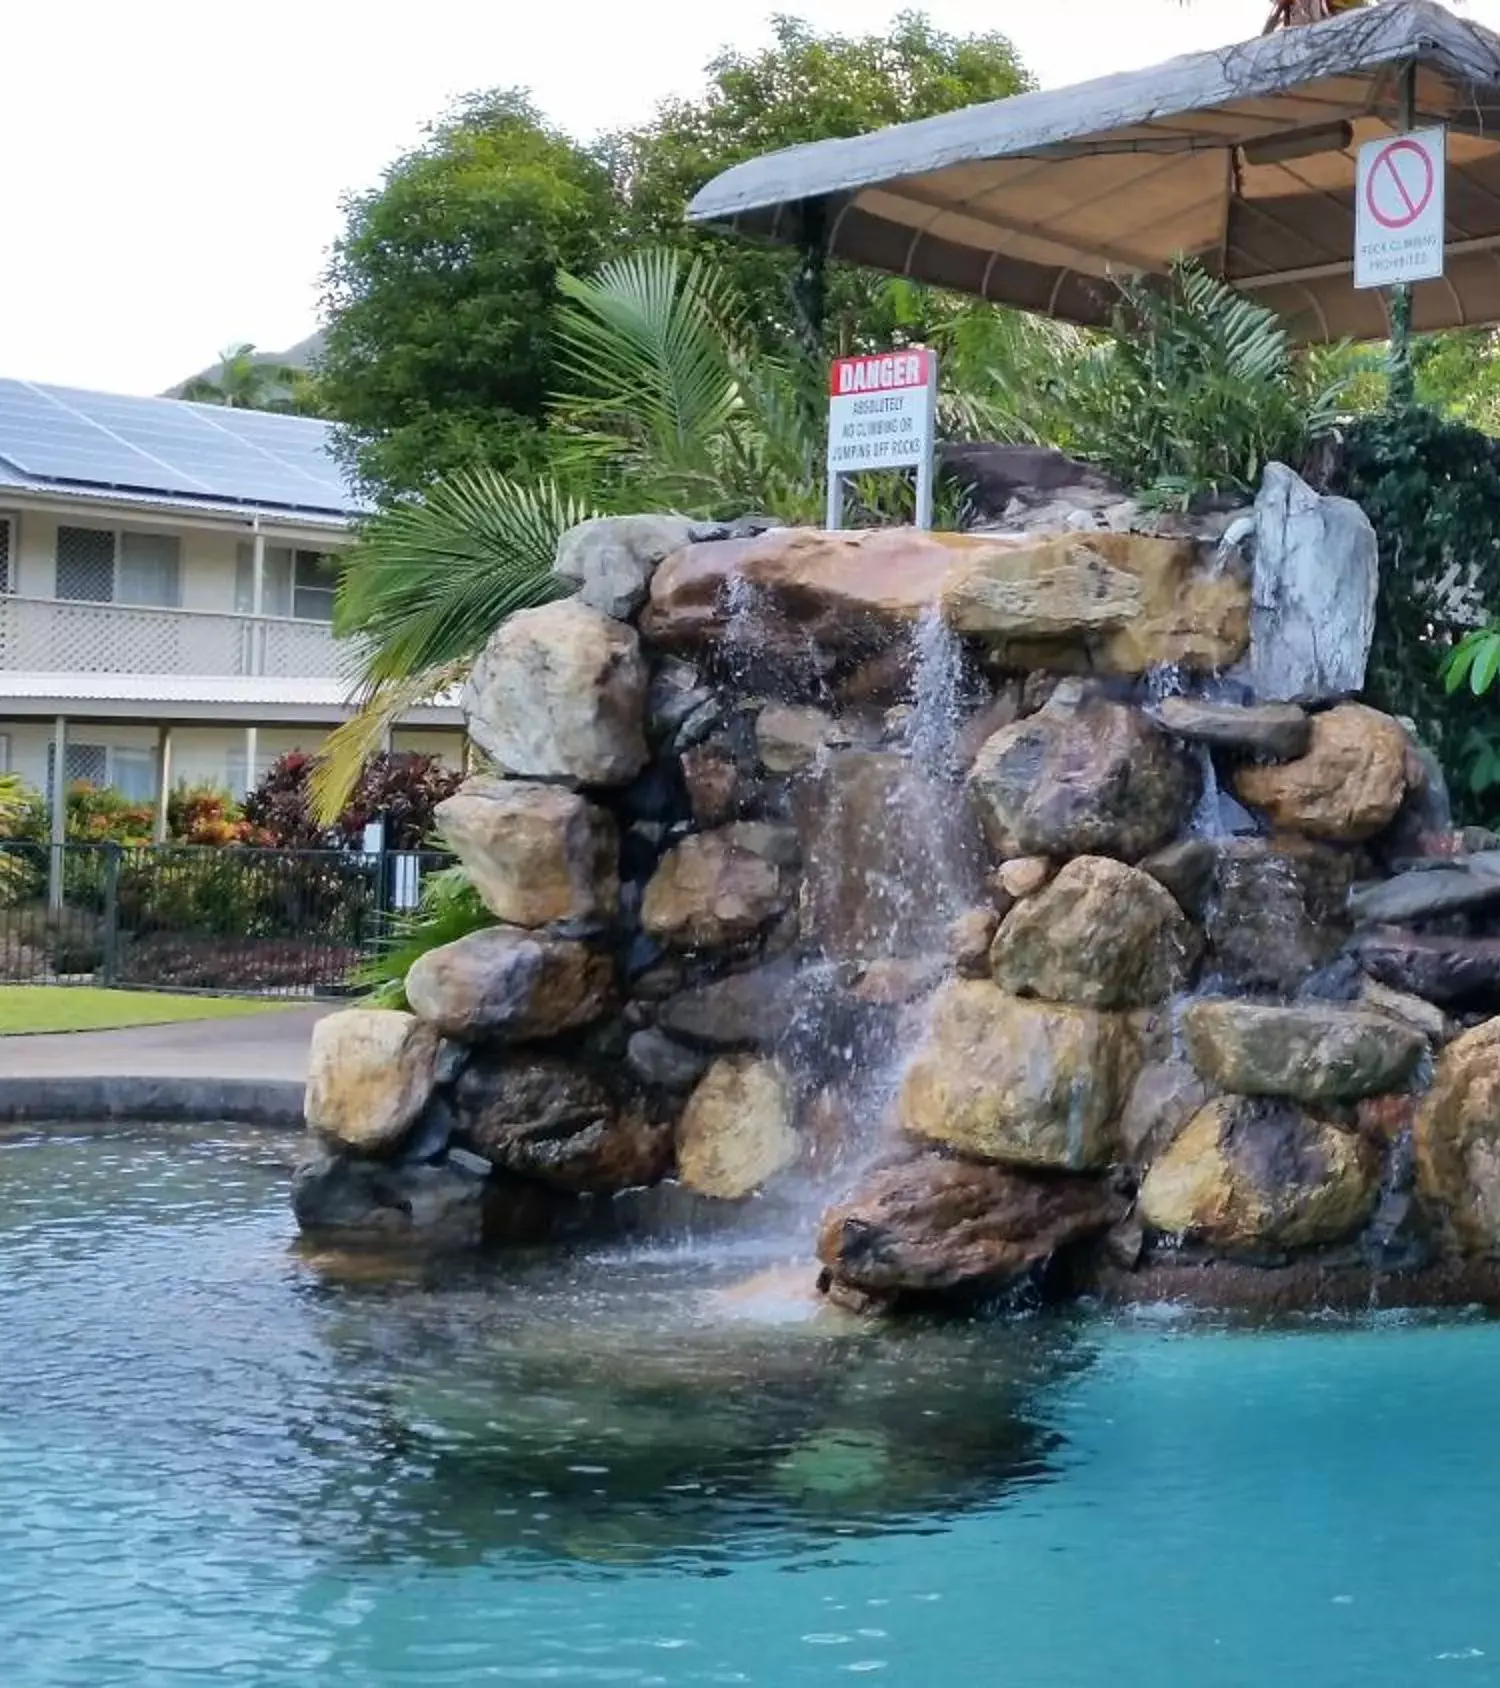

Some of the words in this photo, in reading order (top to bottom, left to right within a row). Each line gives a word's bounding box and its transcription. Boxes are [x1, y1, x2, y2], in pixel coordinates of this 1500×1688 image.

[839, 354, 920, 393] DANGER
[852, 397, 903, 414] ABSOLUTELY
[843, 423, 855, 438] NO
[856, 419, 897, 437] CLIMBING
[900, 417, 912, 433] OR
[832, 443, 871, 461] JUMPING
[873, 440, 890, 457] OFF
[892, 437, 920, 455] ROCKS
